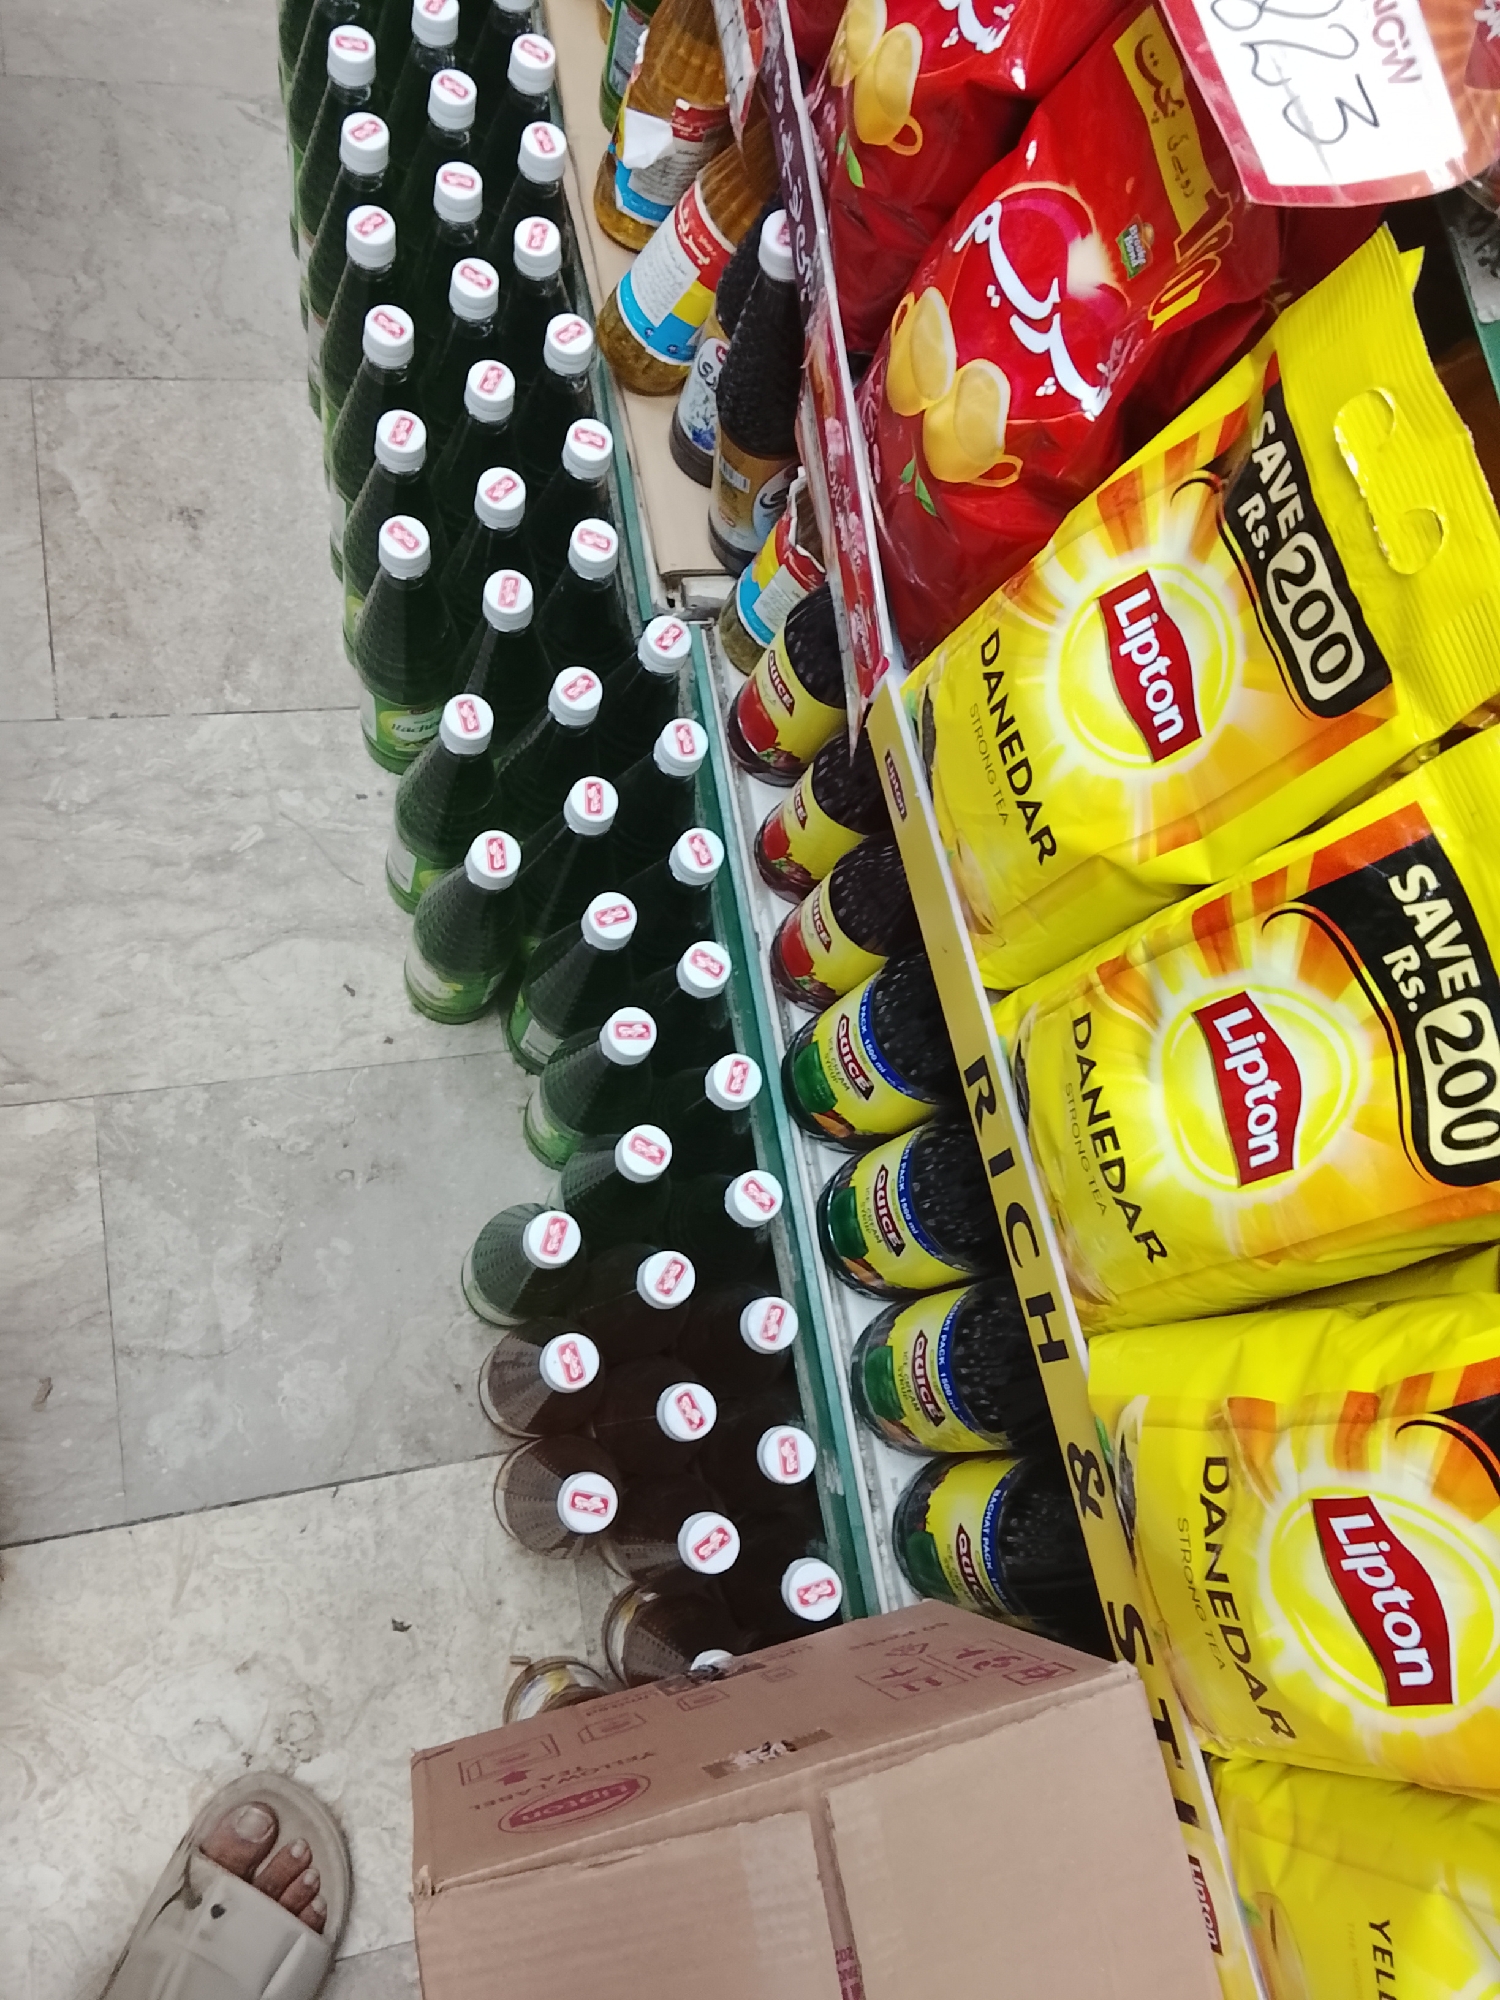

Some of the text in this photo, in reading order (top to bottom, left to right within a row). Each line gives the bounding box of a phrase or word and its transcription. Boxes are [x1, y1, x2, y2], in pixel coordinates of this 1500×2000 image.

[953, 199, 1113, 421] سپریم
[1250, 410, 1305, 540] SAVE
[1237, 493, 1353, 684] Rs. 200
[1113, 587, 1185, 745] Lipton
[969, 702, 1010, 826] STRONG TEA
[980, 628, 1057, 866] DANEDAR
[1388, 864, 1482, 999] SAVE
[837, 1017, 873, 1091] QUICE
[1213, 1007, 1283, 1168] Lipton
[1382, 944, 1500, 1150] Rs. 200
[876, 1171, 902, 1248] QUICE
[1064, 1082, 1108, 1217] STRONG TEA
[1072, 1012, 1168, 1263] DANEDAR
[914, 1336, 942, 1418] QUICE
[938, 1334, 948, 1366] PACK
[963, 1054, 1201, 1827] RICH & ST
[982, 1489, 1001, 1535] BACHAT
[981, 1536, 993, 1570] PACK
[1177, 1517, 1226, 1670] STRONG TEA
[1199, 1456, 1297, 1740] DANEDAR
[1328, 1513, 1434, 1687] Lipton
